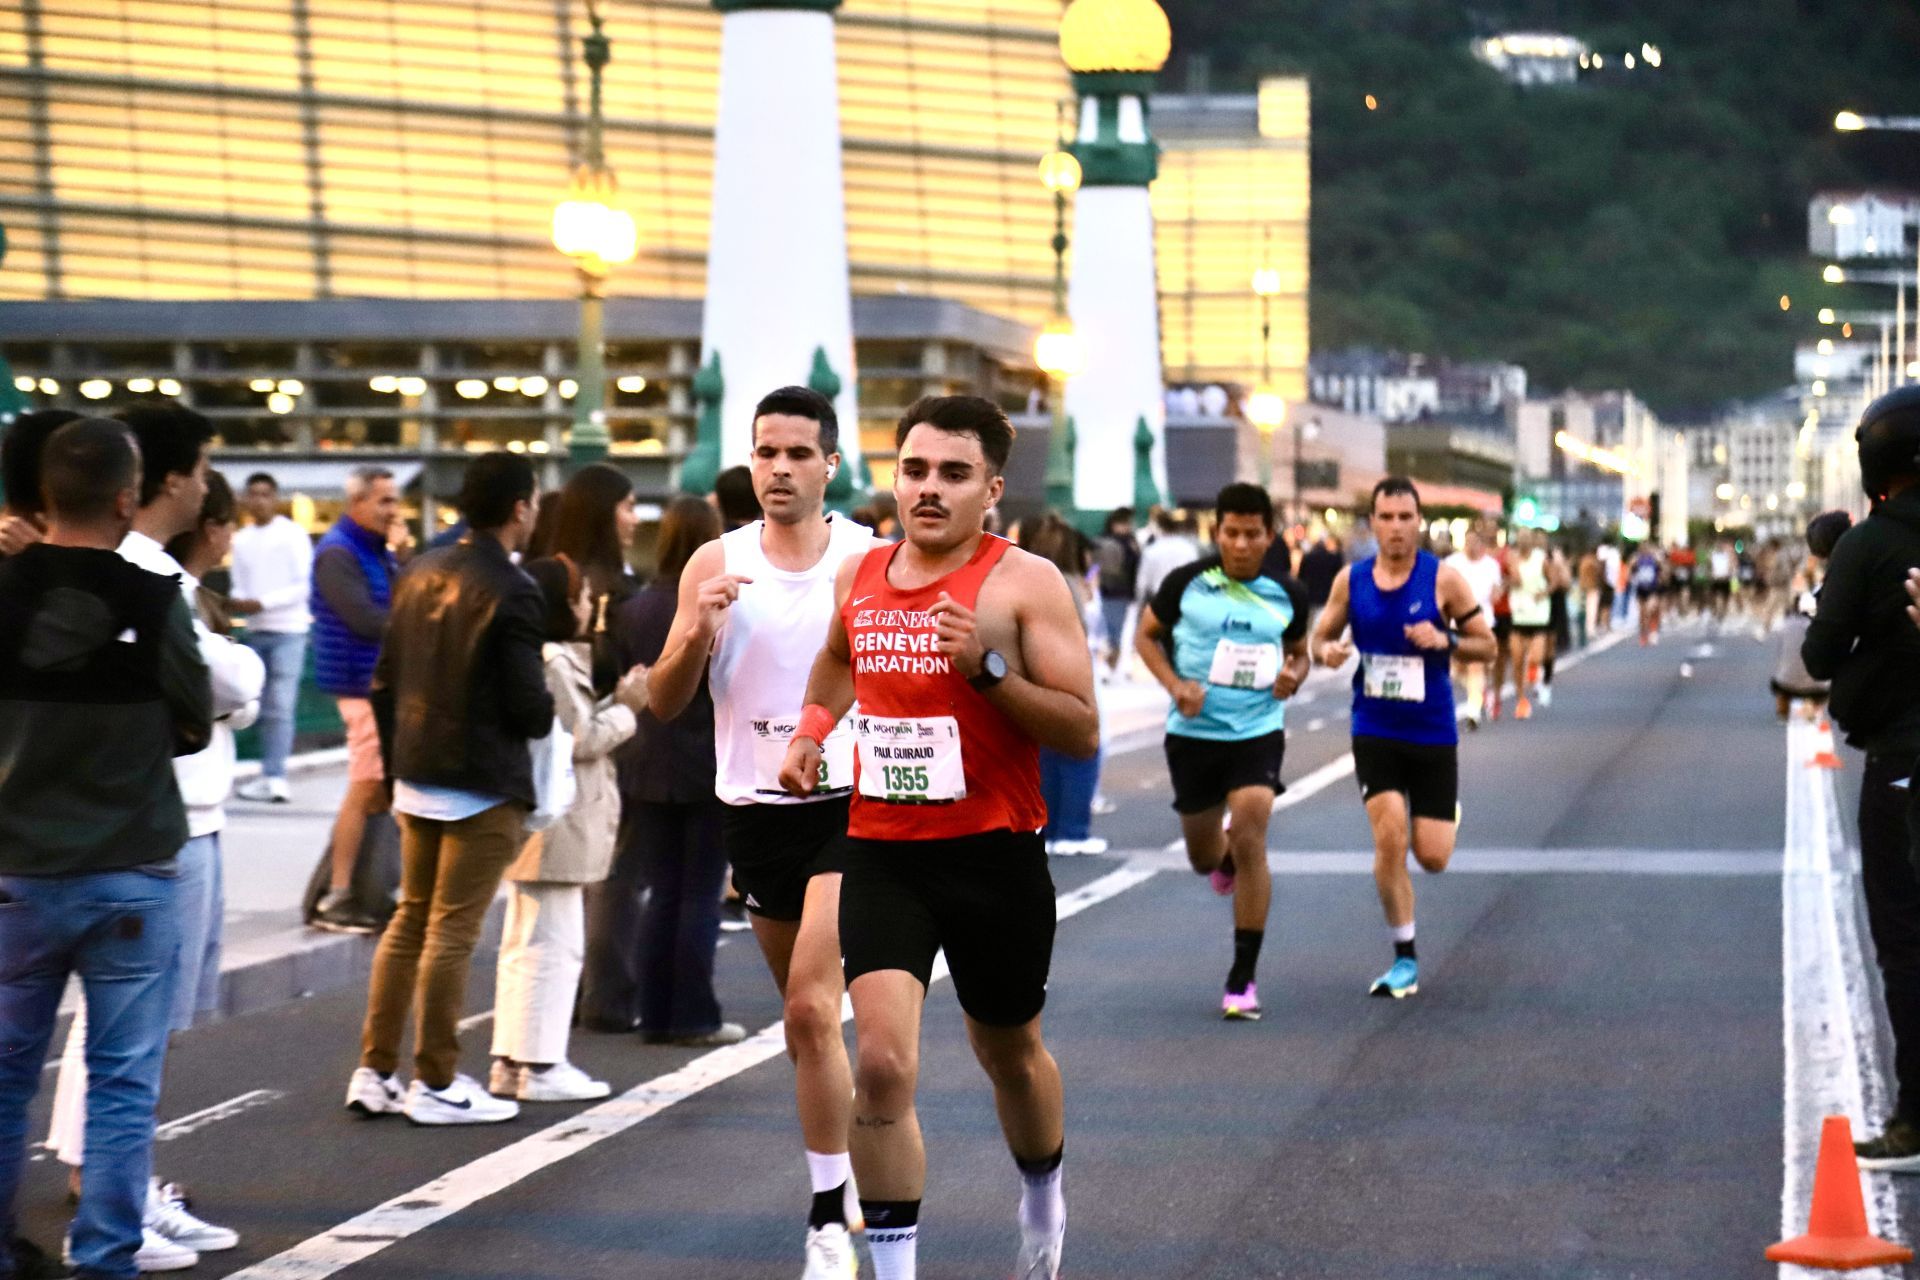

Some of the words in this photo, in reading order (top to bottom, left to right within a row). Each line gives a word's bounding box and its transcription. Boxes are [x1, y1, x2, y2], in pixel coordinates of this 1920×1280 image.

[856, 655, 950, 675] MARATHON
[947, 726, 953, 738] 1
[873, 746, 892, 759] PAUL
[893, 746, 934, 760] GUIRAUD
[882, 765, 929, 791] 1355
